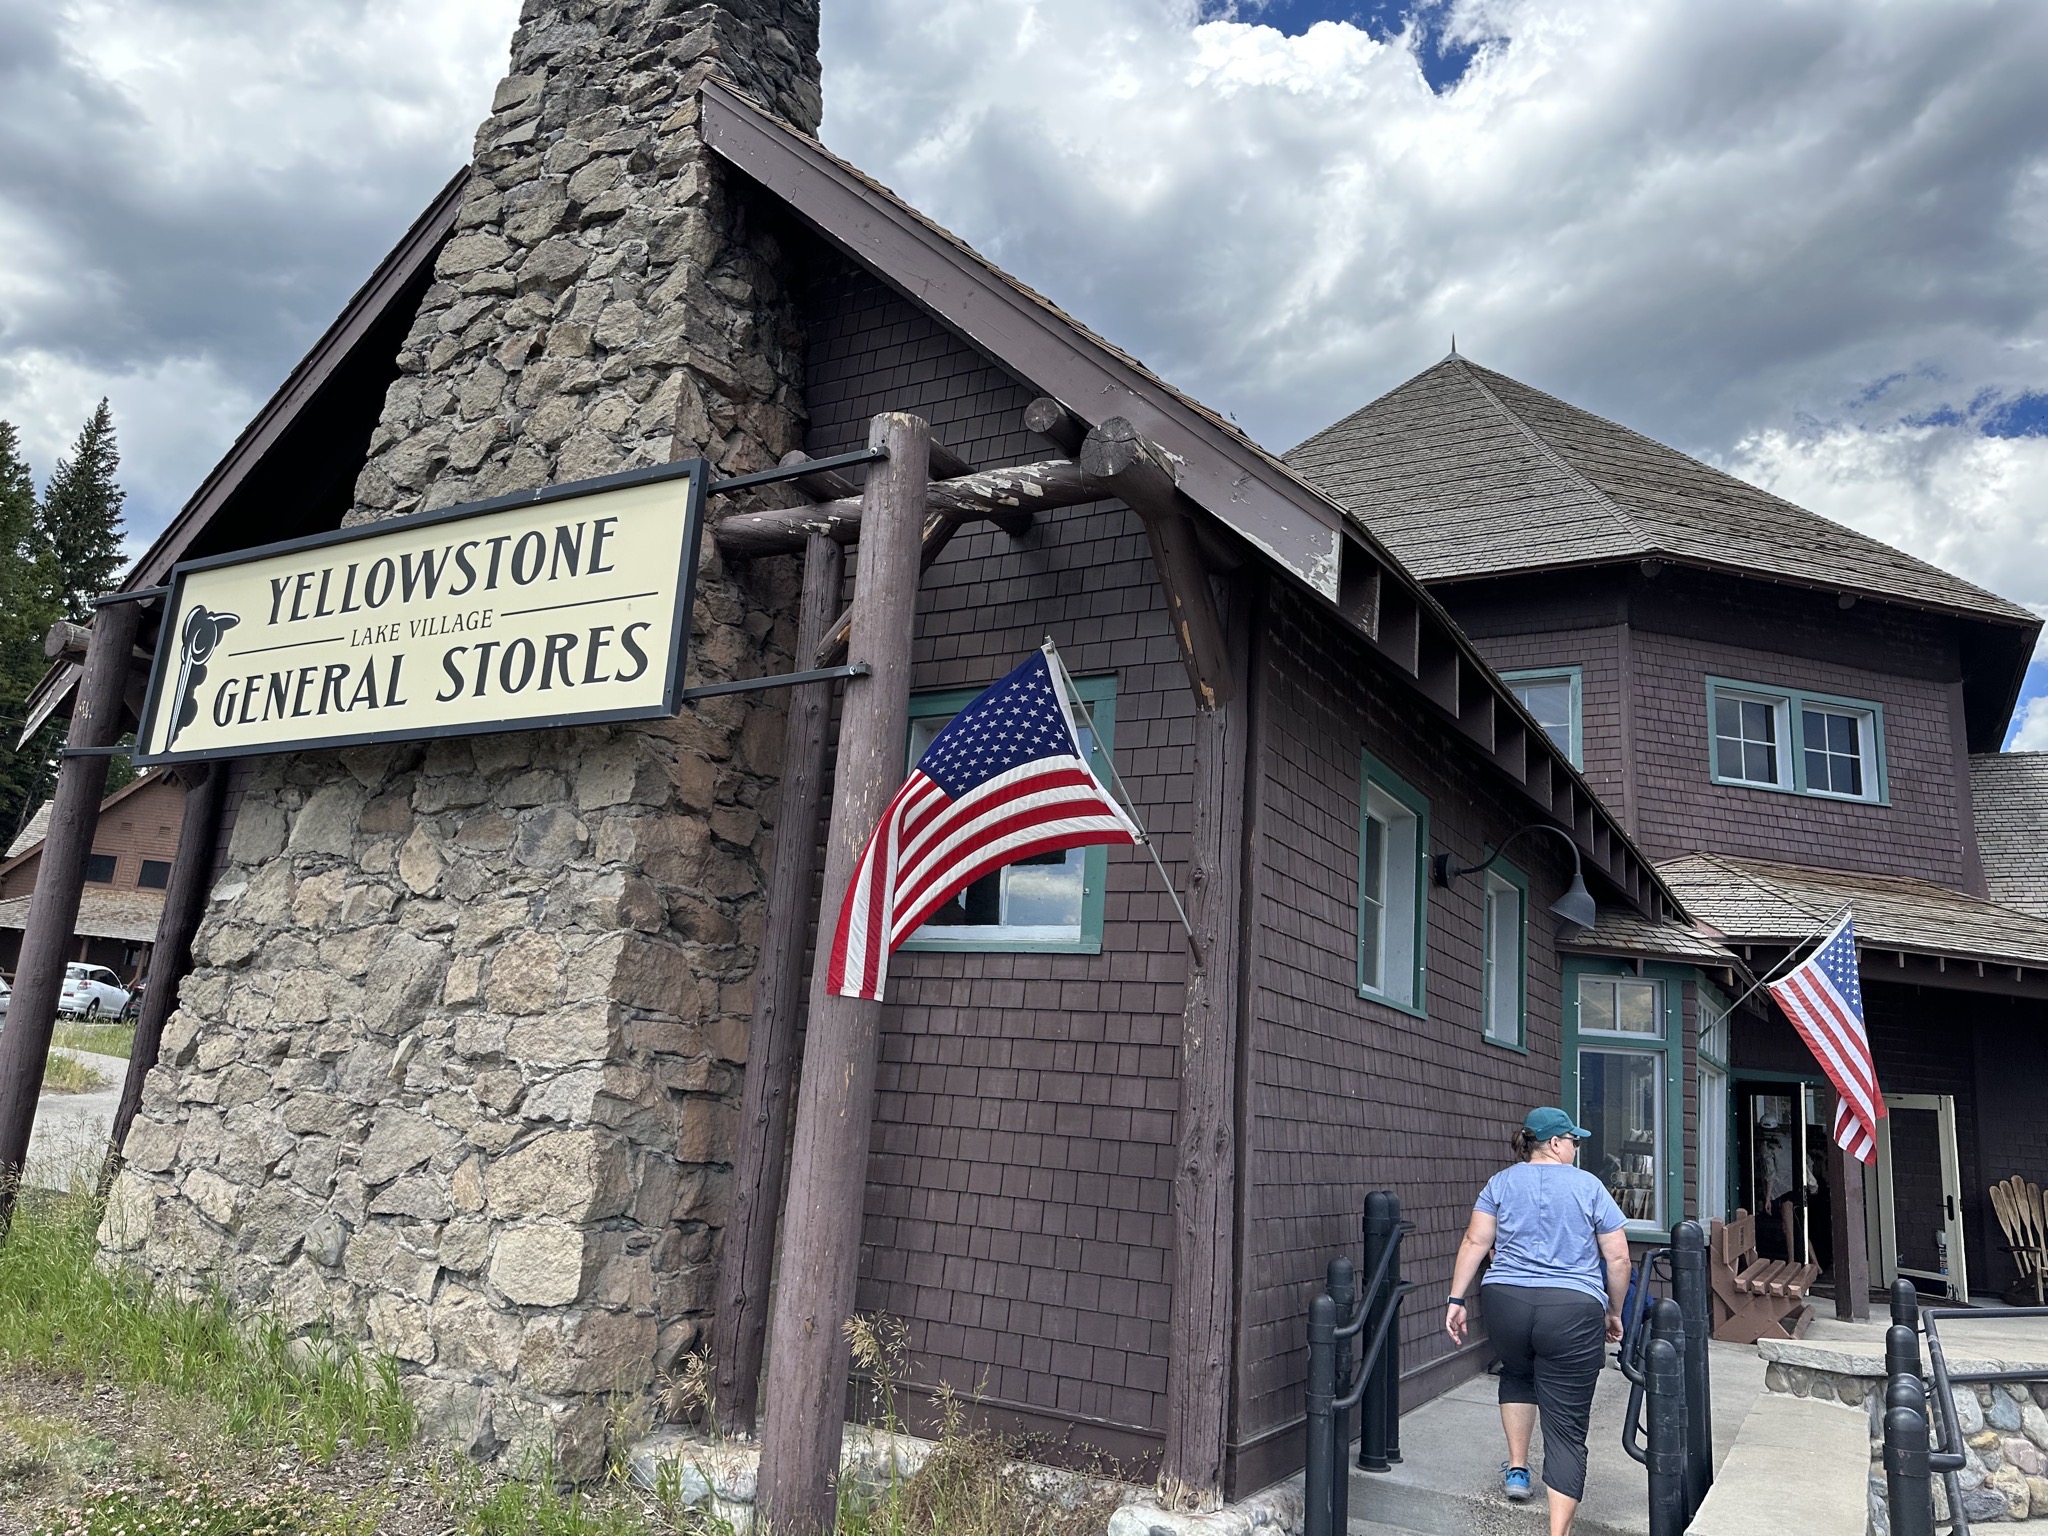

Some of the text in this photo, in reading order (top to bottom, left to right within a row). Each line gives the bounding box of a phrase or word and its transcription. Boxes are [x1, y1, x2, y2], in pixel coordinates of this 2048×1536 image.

[267, 516, 619, 626] YELLOWSTONE
[212, 621, 652, 728] GENERAL STORES
[350, 608, 494, 648] LAKE VILLAGE
